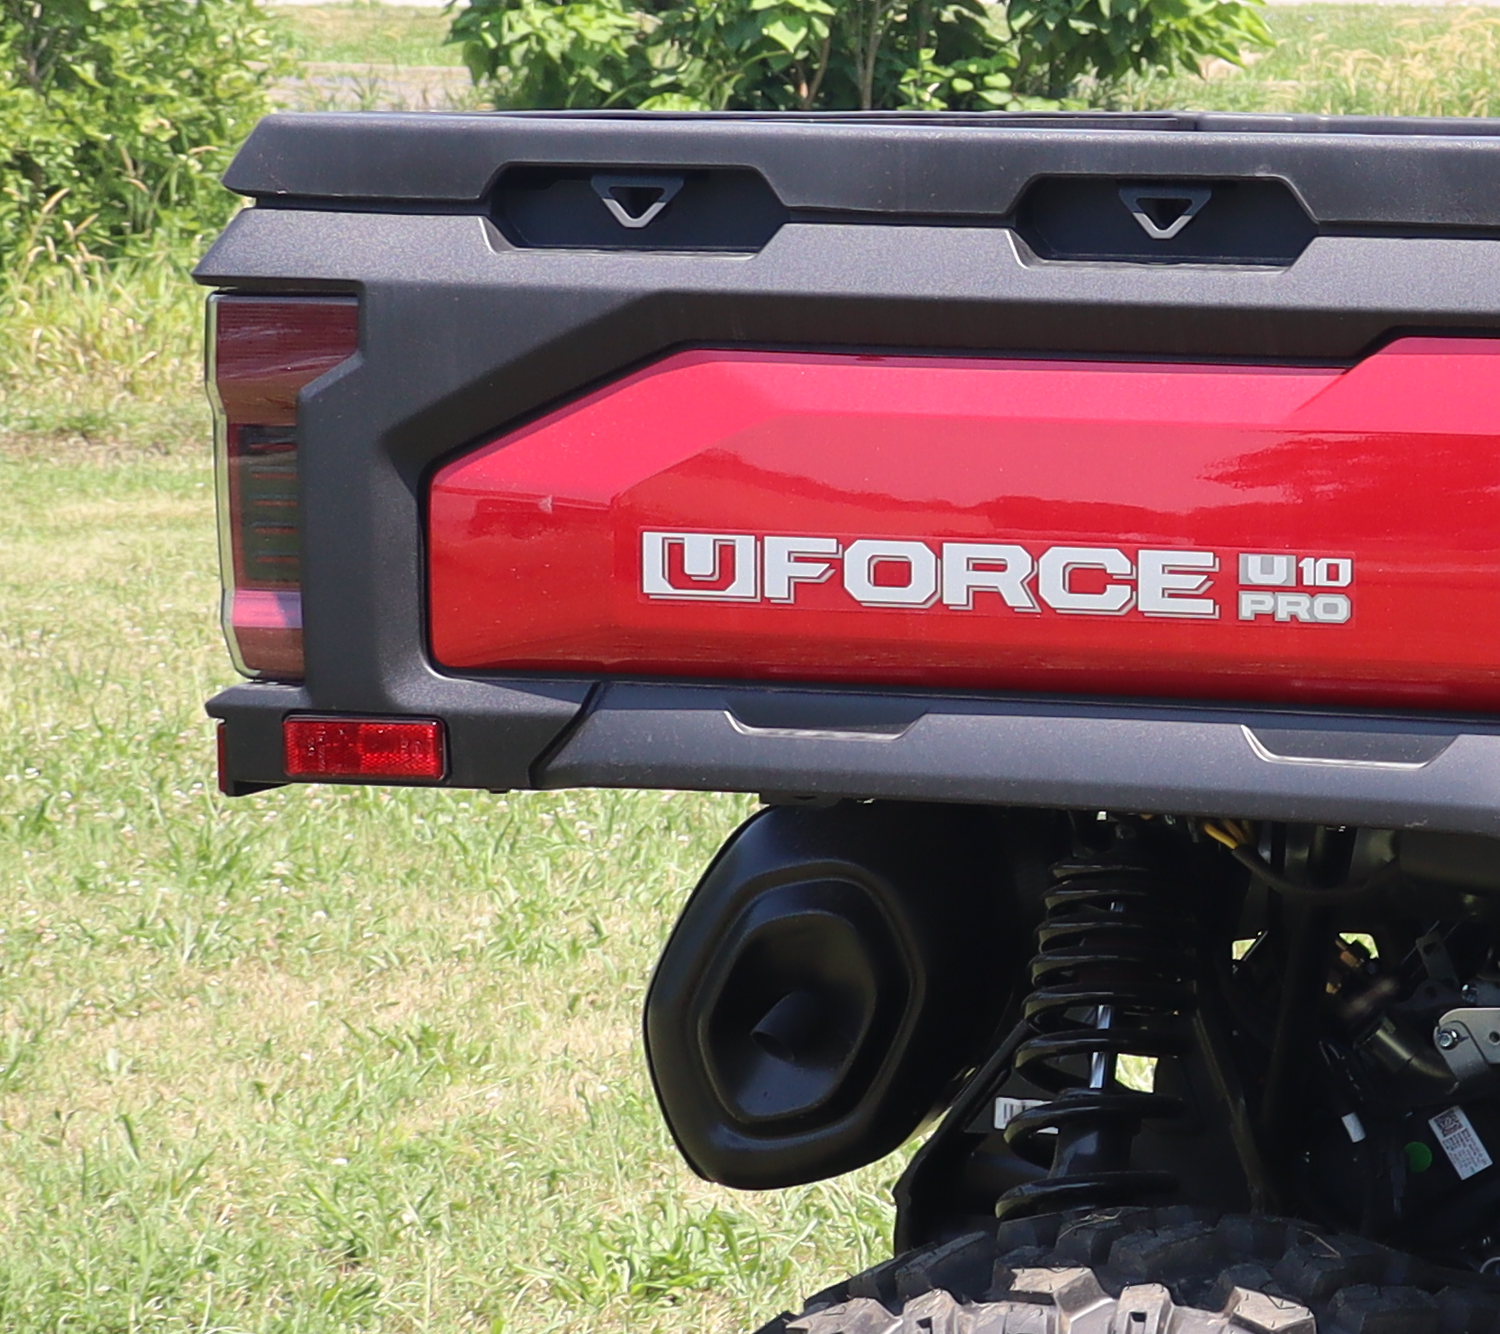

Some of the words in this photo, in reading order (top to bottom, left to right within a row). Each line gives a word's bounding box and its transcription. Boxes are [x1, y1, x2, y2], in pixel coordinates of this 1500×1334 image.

[641, 531, 1221, 619] UFORCE
[1238, 553, 1352, 588] U10
[1238, 592, 1352, 623] PRO
